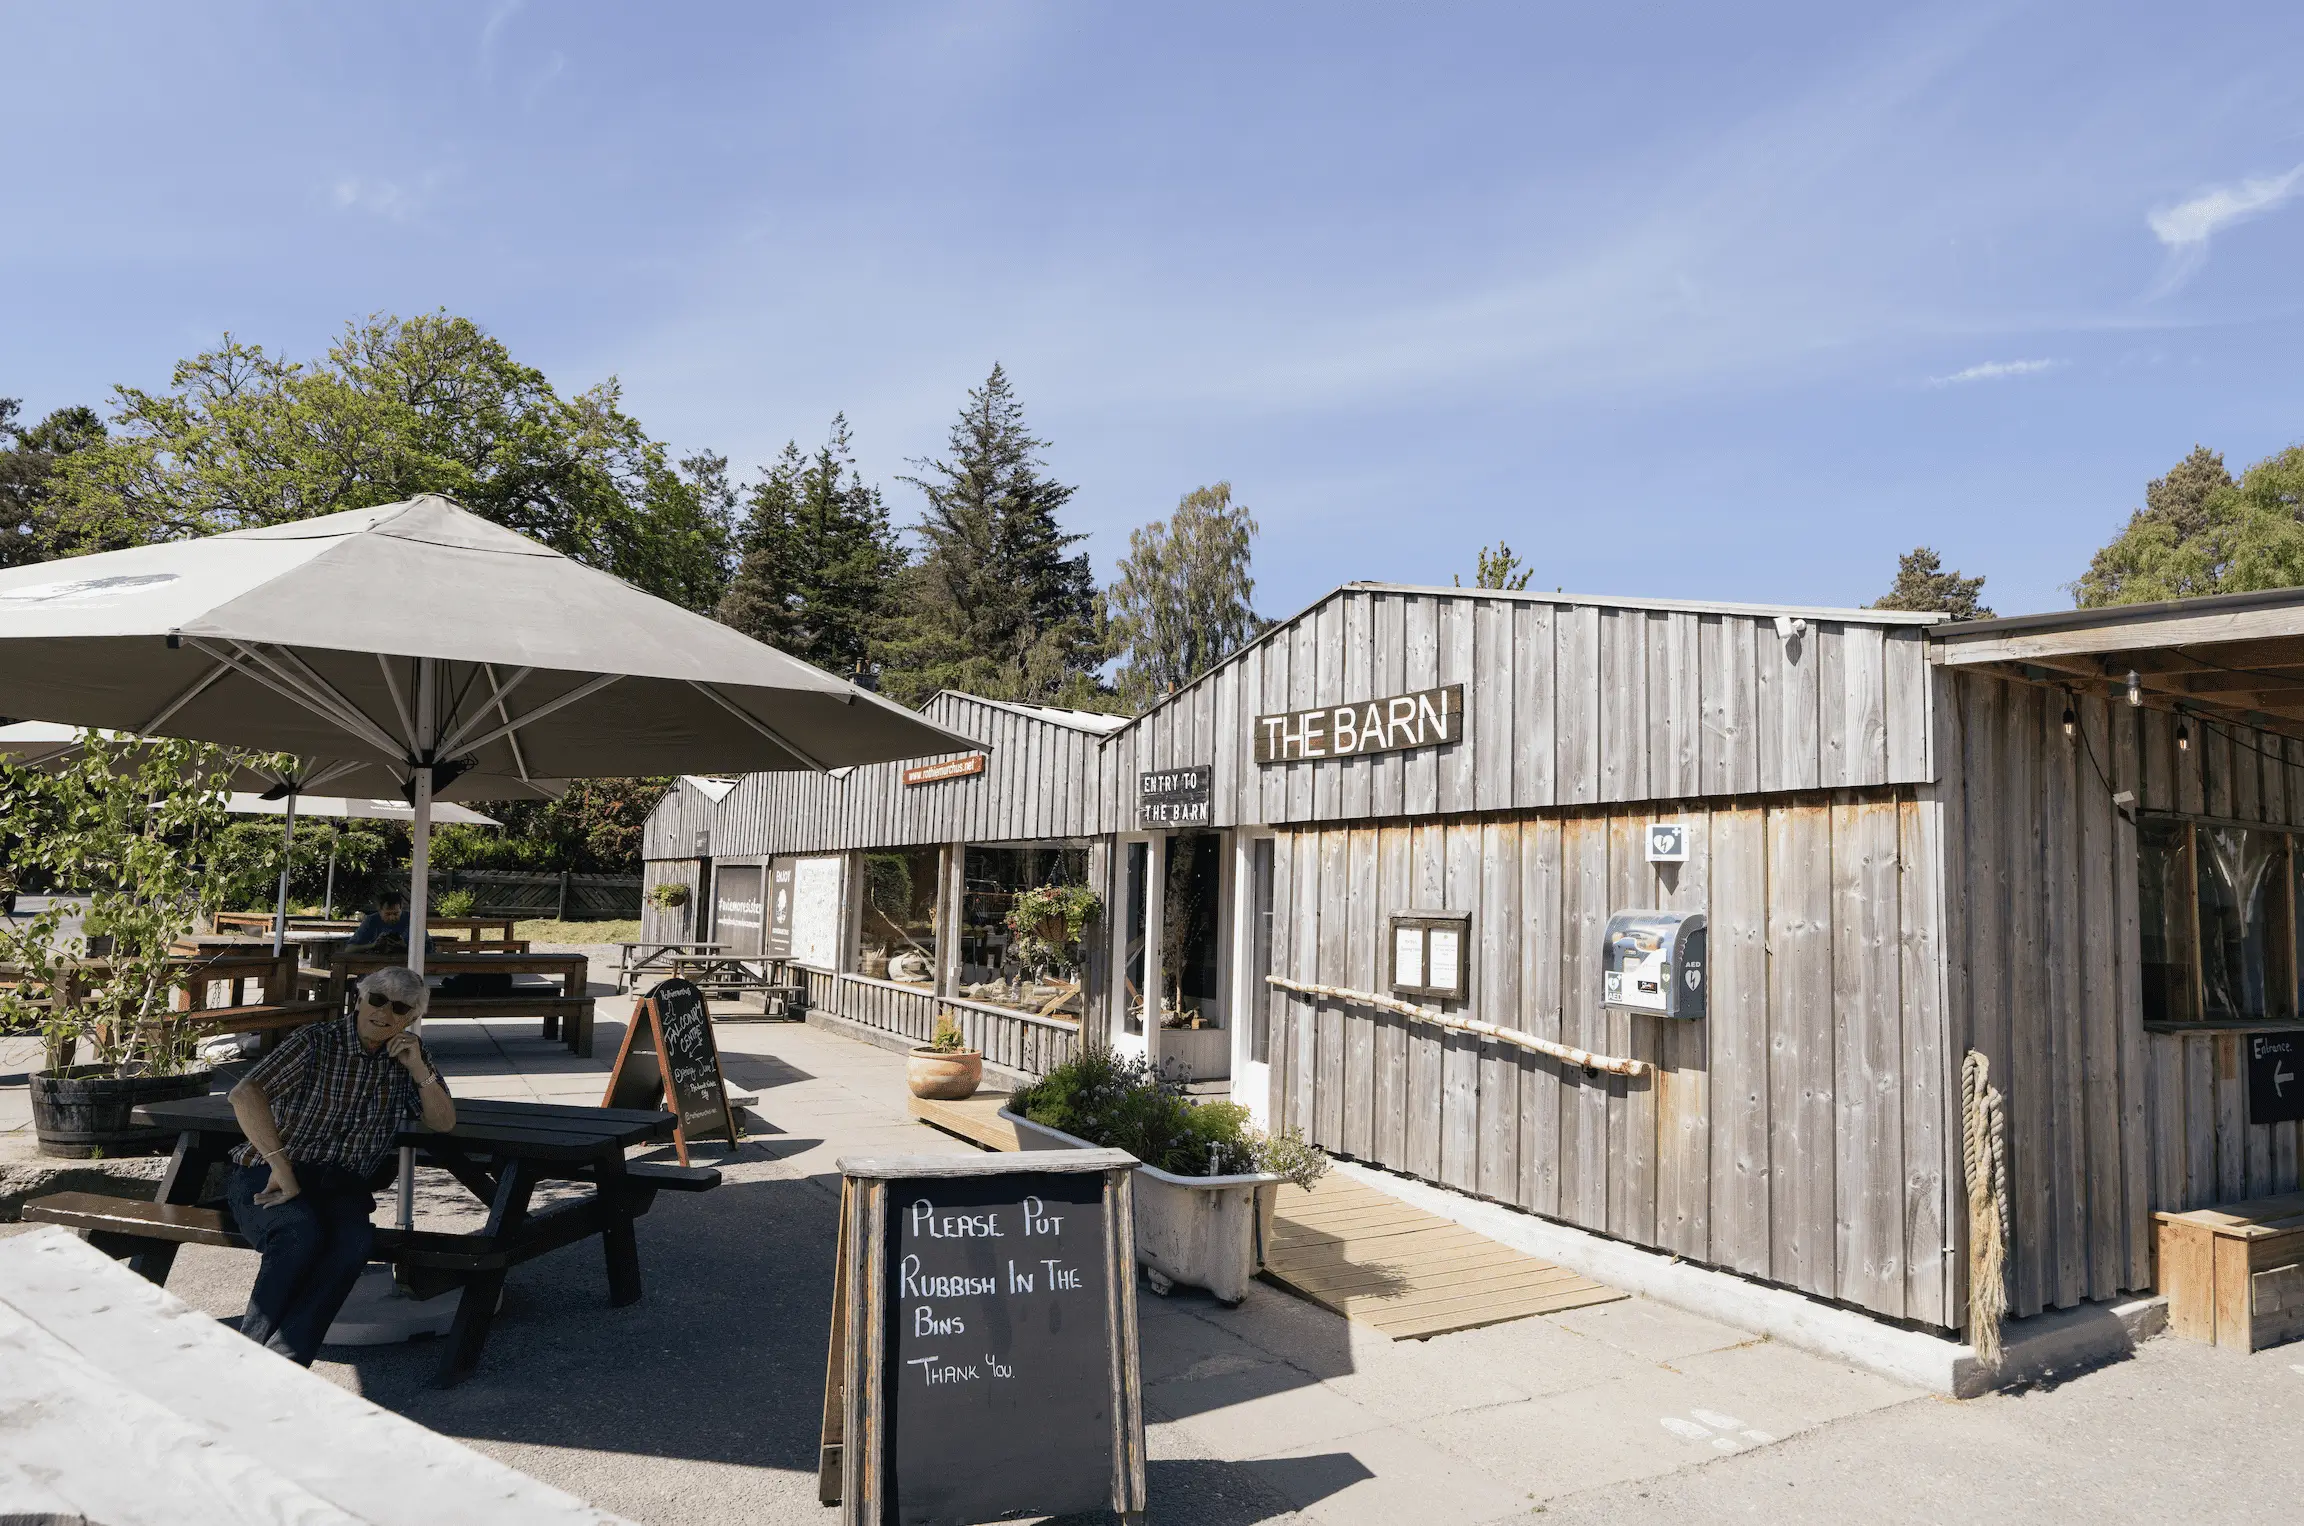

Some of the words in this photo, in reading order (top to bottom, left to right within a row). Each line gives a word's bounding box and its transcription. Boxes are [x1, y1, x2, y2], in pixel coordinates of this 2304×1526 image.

[1262, 711, 1326, 760] THE
[1333, 690, 1448, 754] BARN
[908, 759, 975, 781] www.rothiemurchus.net
[1144, 774, 1178, 793] ENTRY
[1184, 772, 1197, 790] TO
[1145, 804, 1167, 821] THE
[1173, 802, 1207, 820] BARN
[1608, 992, 1622, 1000] AED
